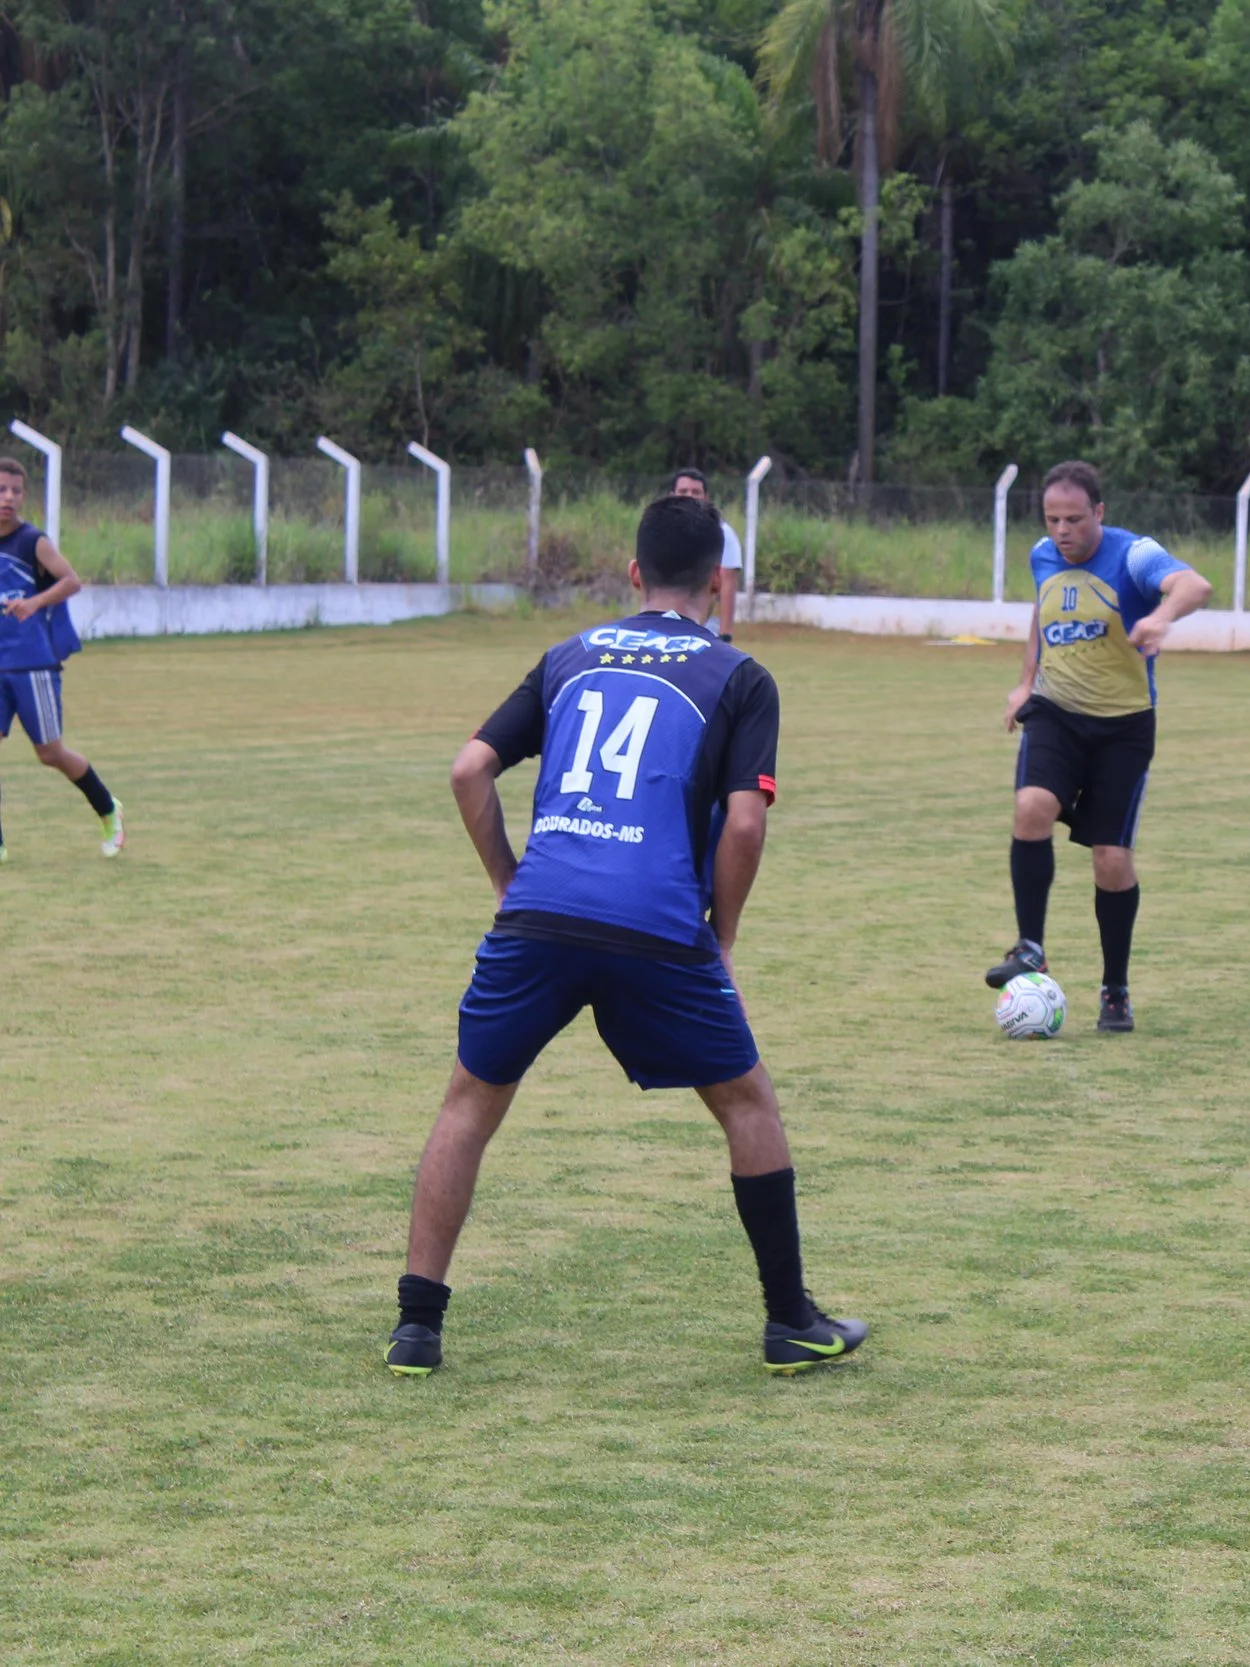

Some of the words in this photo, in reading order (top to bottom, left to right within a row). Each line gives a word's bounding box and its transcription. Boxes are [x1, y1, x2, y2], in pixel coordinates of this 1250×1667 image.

[1061, 586, 1079, 612] 10
[560, 689, 660, 800] 14
[533, 815, 645, 844] DOURADOS-MS
